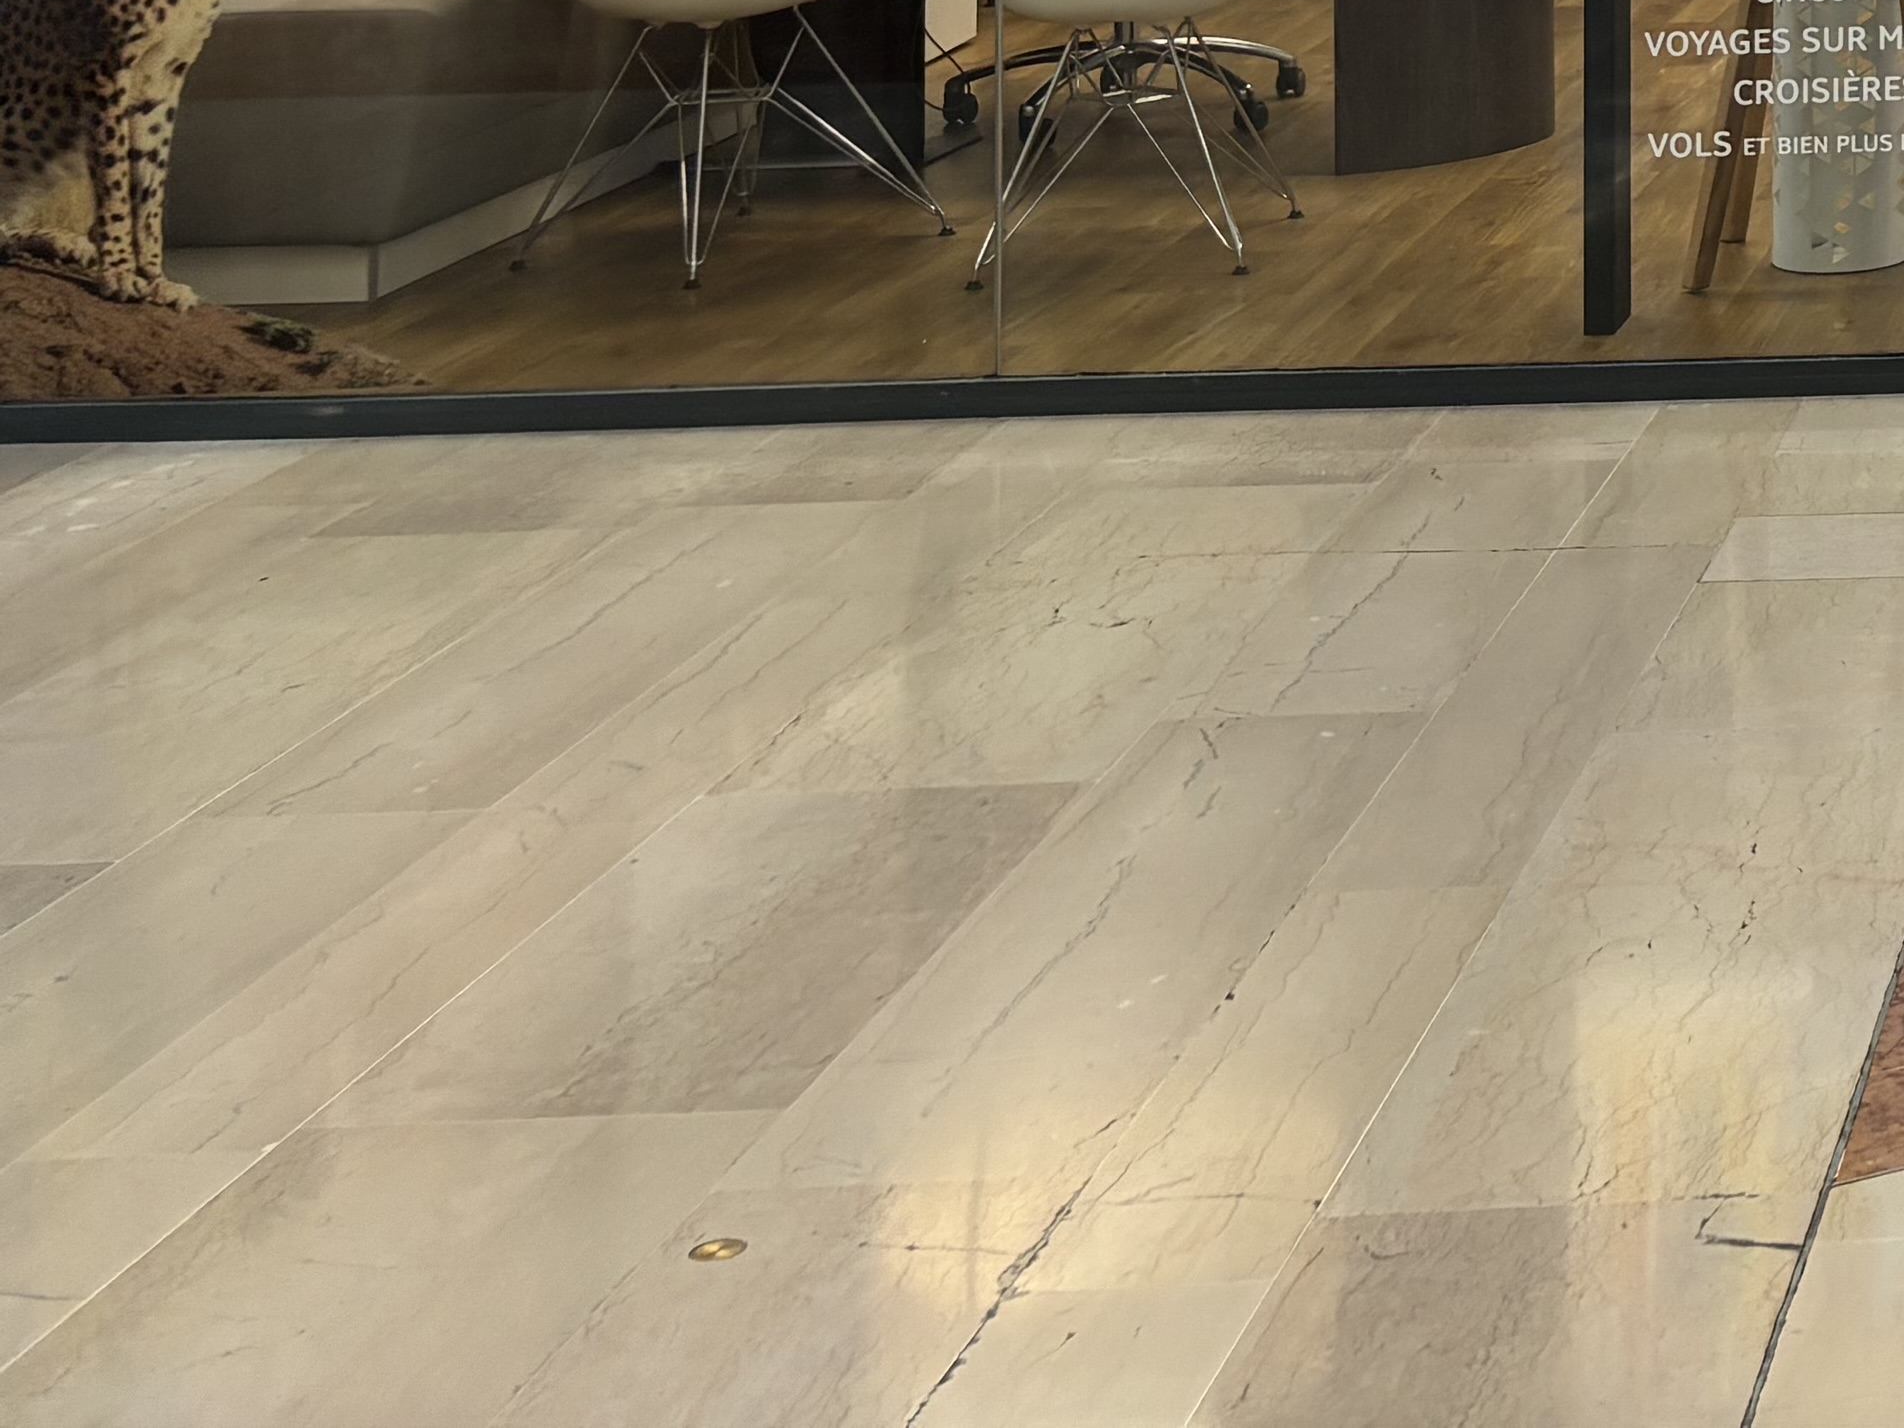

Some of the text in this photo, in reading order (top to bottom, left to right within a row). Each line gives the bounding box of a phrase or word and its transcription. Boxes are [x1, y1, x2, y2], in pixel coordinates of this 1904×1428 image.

[1644, 26, 1791, 58] VOYAGES
[1801, 25, 1867, 54] SUR
[1647, 131, 1732, 159] VOLS
[1743, 135, 1770, 156] ET
[1777, 134, 1829, 155] BIEN
[1836, 133, 1893, 154] PLUS
